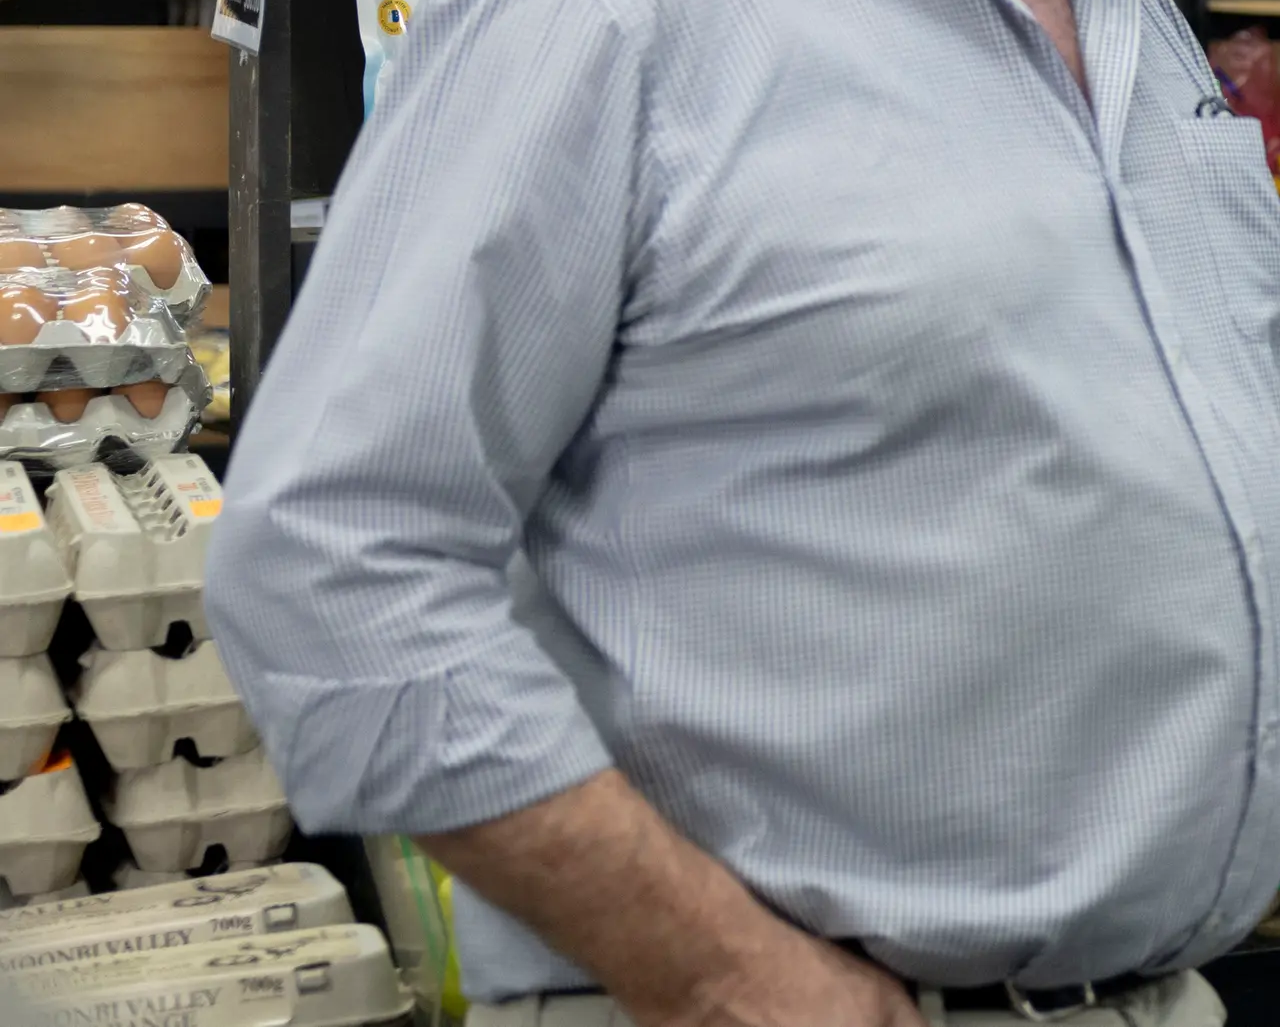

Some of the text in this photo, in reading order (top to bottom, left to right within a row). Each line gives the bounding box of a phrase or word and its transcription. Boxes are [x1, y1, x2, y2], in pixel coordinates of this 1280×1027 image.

[209, 915, 254, 934] 700g
[105, 928, 194, 955] VALLEY
[239, 977, 285, 995] 700g
[125, 986, 223, 1018] VALLEY
